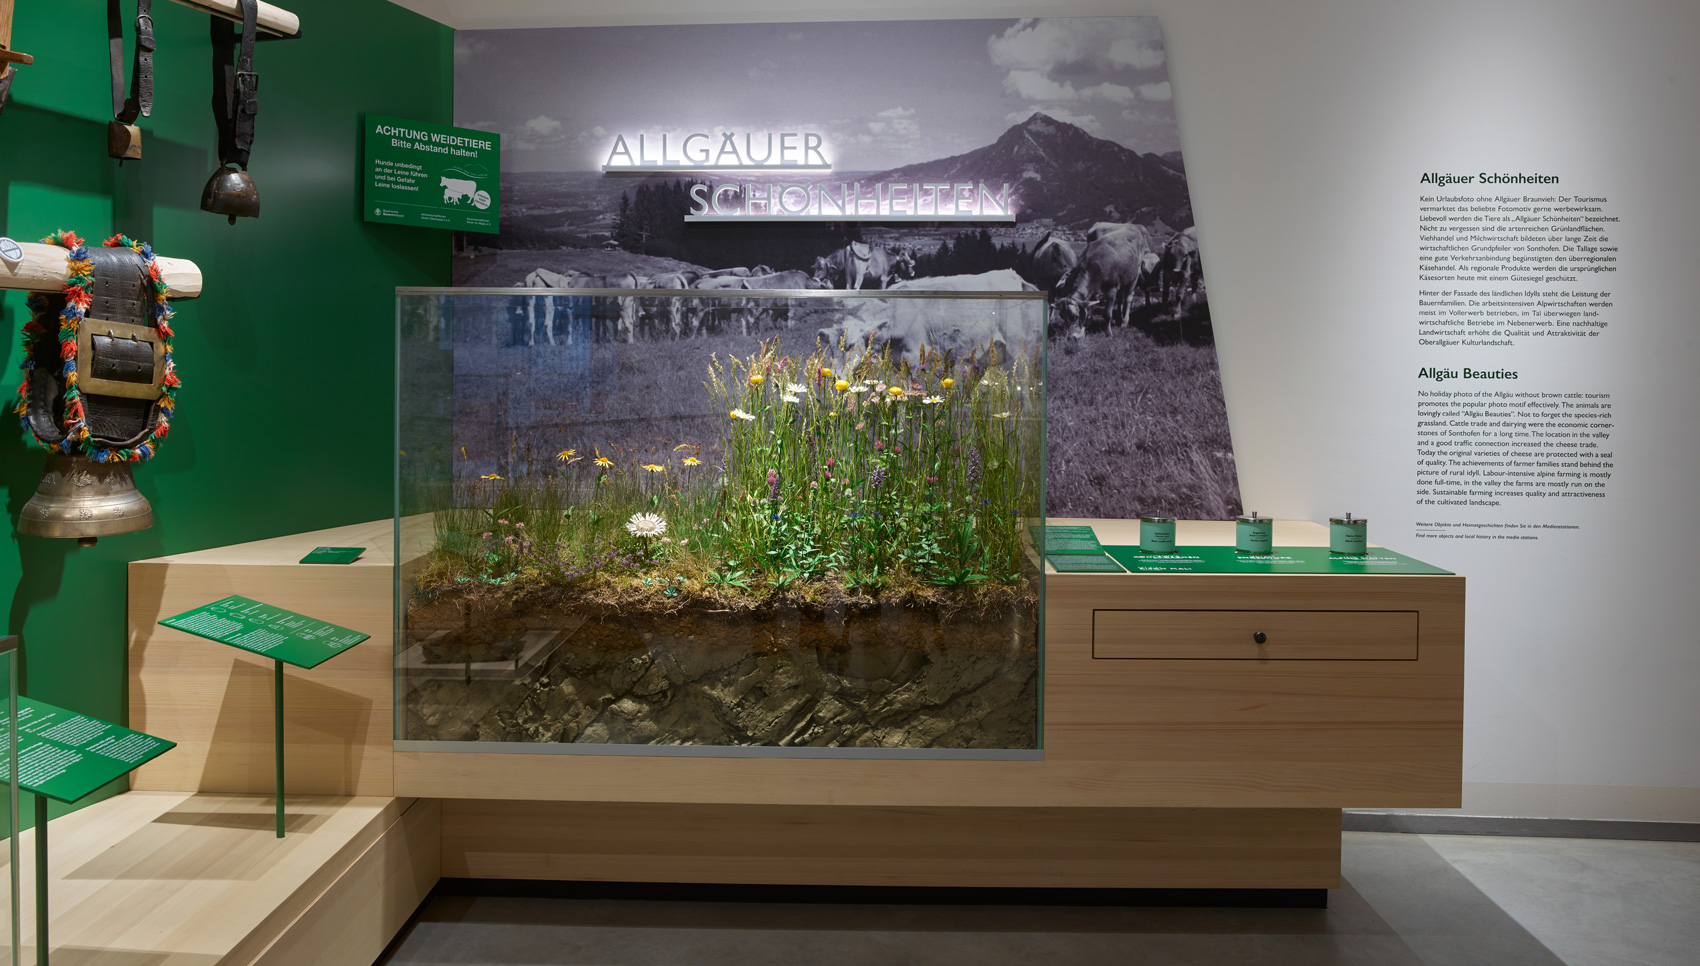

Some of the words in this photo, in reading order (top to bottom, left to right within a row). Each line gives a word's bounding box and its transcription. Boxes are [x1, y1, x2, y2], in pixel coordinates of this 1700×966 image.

[375, 124, 428, 141] ACHTUNG
[431, 133, 492, 151] WEIDETIERE
[391, 139, 412, 149] Bitte
[414, 142, 448, 154] Abstand
[450, 146, 478, 158] halten!
[606, 131, 829, 166] ALLGÄUER
[395, 163, 422, 171] unbedingt
[1420, 172, 1475, 187] Allgäuer
[1479, 172, 1559, 184] Schönheiten
[392, 183, 419, 191] loslassen!
[689, 183, 1010, 217] SCHÖNHEITEN
[1436, 195, 1474, 203] Urlaubsfoto
[1494, 195, 1521, 204] Allgäuer
[1523, 195, 1556, 203] Braunvieh:
[1573, 195, 1607, 203] Tourismus
[1511, 215, 1541, 224] „Allgäuer
[1585, 215, 1620, 223] bezeichnet.
[1449, 226, 1480, 234] vergessen
[1551, 225, 1605, 233] Grünlandflächen.
[1419, 244, 1469, 252] wirtschaftlichen
[1471, 244, 1511, 253] Grundpfeiler
[1576, 245, 1598, 254] Tallage
[1450, 255, 1511, 263] Verkehrsanbindung
[1512, 255, 1553, 263] begünstigten
[1569, 255, 1616, 264] überregionalen
[1471, 264, 1499, 273] regionale
[1501, 264, 1530, 272] Produkte
[1570, 265, 1616, 274] ursprünglichen
[1510, 274, 1544, 283] Gütesiegel
[1545, 275, 1578, 284] geschützt.
[1419, 299, 1466, 307] Bauernfamilien.
[1469, 299, 1480, 307] Die
[1536, 300, 1587, 309] Alpwirtschaften
[1588, 300, 1613, 308] werden
[1507, 319, 1554, 327] Nebenerwerb.
[1556, 319, 1570, 327] Eine
[1572, 320, 1608, 329] nachhaltige
[1419, 328, 1466, 336] Landwirtschaft
[1504, 329, 1530, 337] Qualität
[1418, 338, 1460, 347] Oberallgäuer
[1418, 367, 1459, 382] Allgäu
[1463, 368, 1518, 380] Beauties
[1430, 390, 1452, 399] holiday
[1454, 390, 1473, 399] photo
[1474, 390, 1481, 398] of
[1494, 391, 1513, 400] Allgäu
[1542, 391, 1562, 399] brown
[1417, 419, 1448, 428] grassland.
[1449, 419, 1469, 427] Cattle
[1502, 420, 1526, 429] dairying
[1435, 439, 1452, 448] good
[1416, 488, 1430, 496] side.
[1432, 488, 1467, 496] Sustainable
[1469, 489, 1493, 498] farming
[1525, 490, 1546, 498] quality
[1436, 498, 1467, 506] cultivated
[1469, 499, 1501, 507] landscape.
